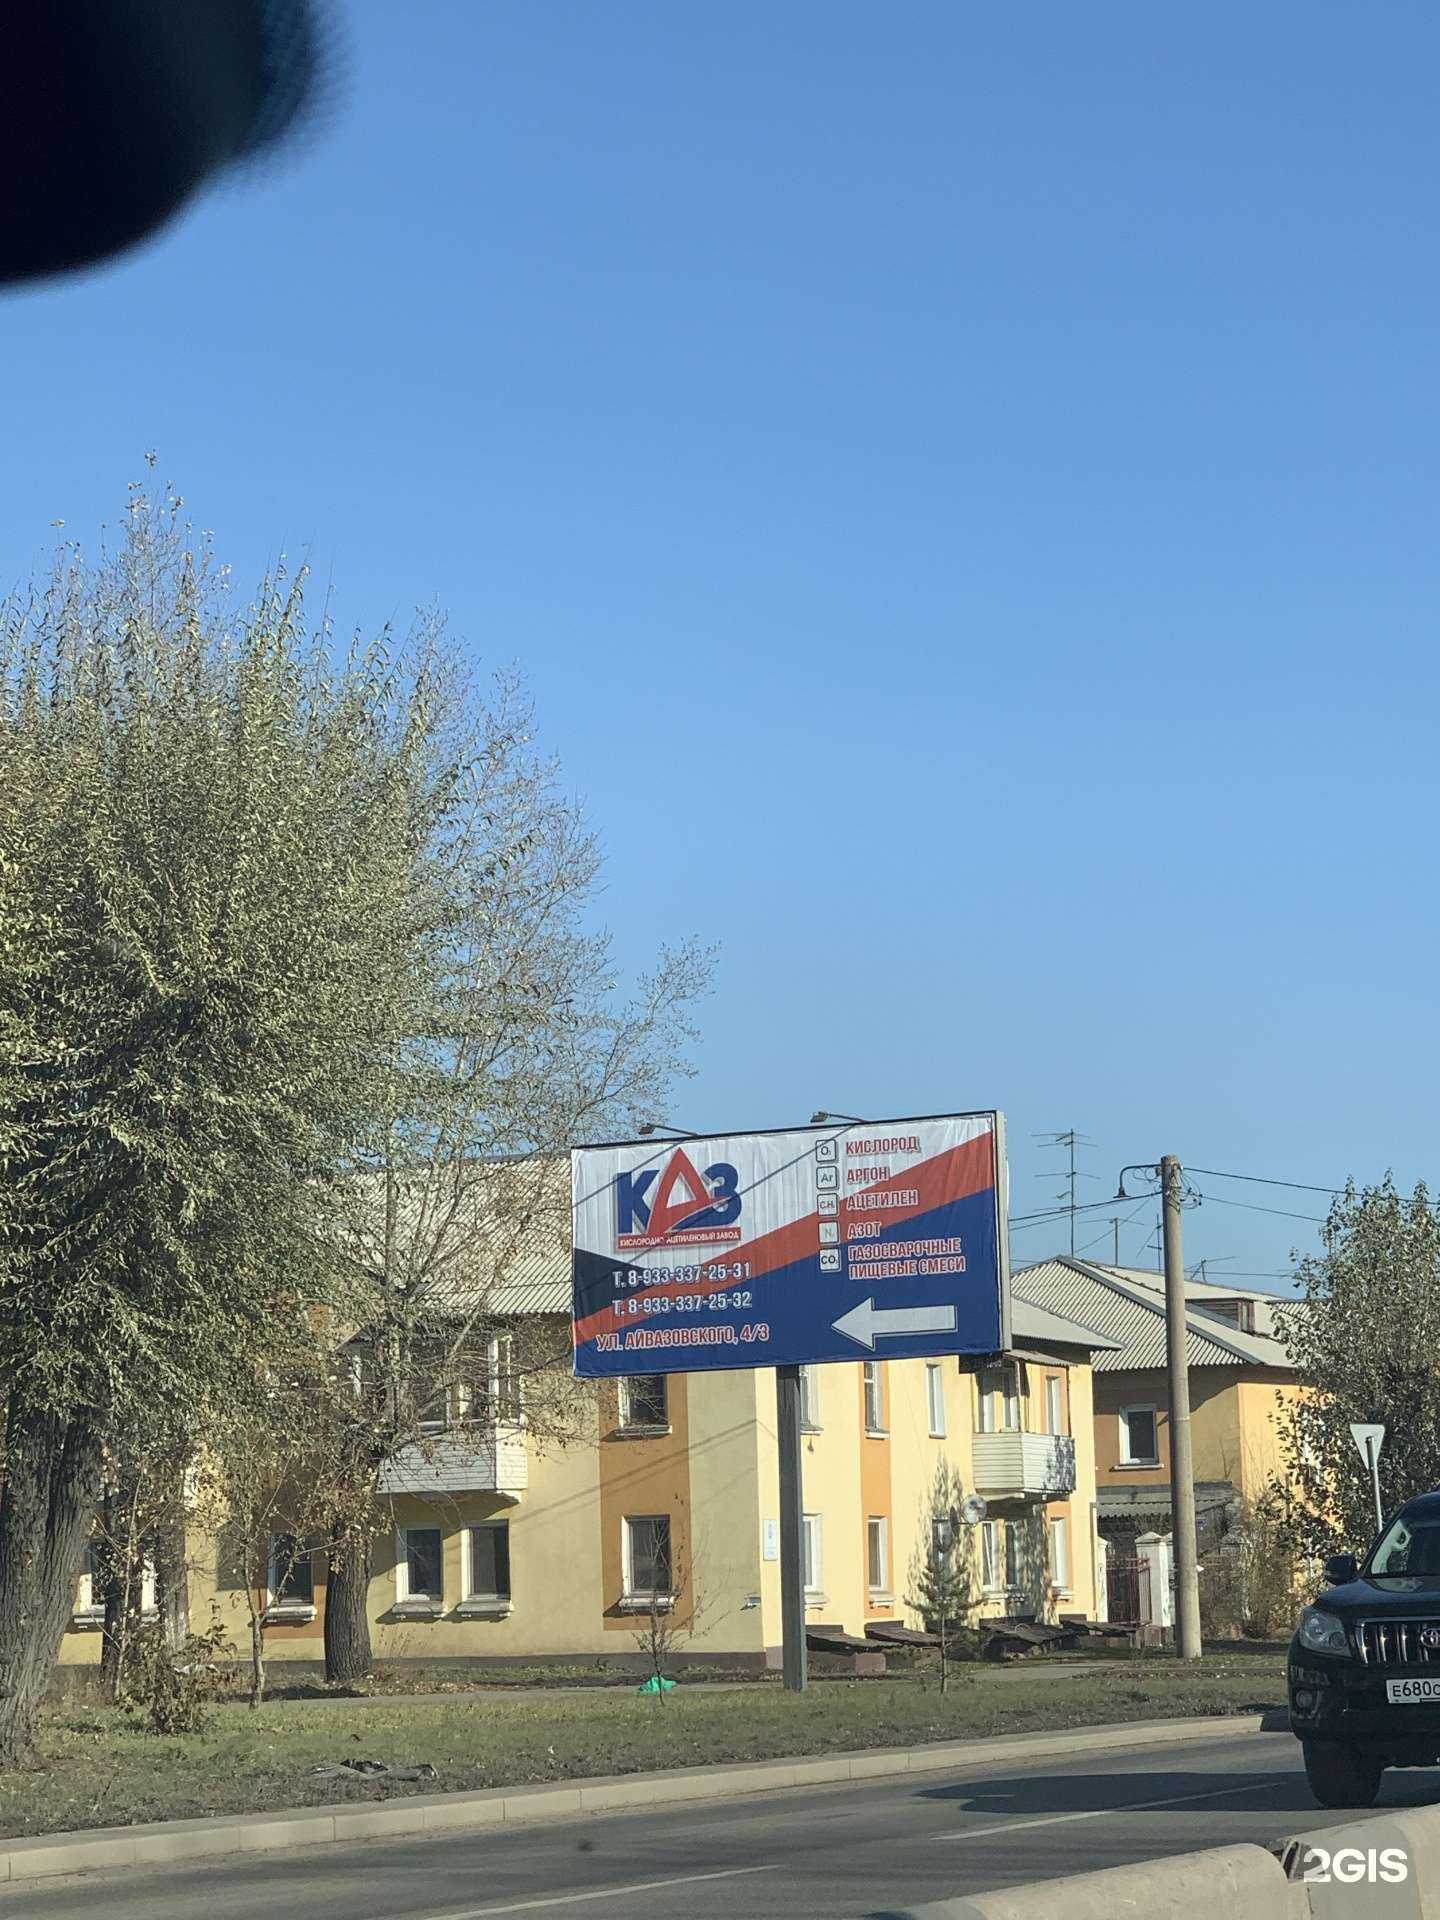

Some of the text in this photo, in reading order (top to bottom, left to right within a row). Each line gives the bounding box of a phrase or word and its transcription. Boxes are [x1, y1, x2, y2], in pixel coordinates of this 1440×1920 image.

[846, 1136, 919, 1155] КИСЛОРОД
[847, 1167, 889, 1183] АРГОН
[847, 1189, 919, 1211] АЦЕТИЛЕН
[847, 1222, 882, 1239] АЗОТ
[848, 1238, 961, 1262] ГАЗОСВАРОЧНЫЕ
[628, 1262, 751, 1286] 8-933-337-25-31
[849, 1256, 966, 1280] ПИЩЕВЫЕ СМЕСИ
[628, 1292, 752, 1313] 8-933-337-25-32
[595, 1324, 769, 1352] УЛ. АЙВАЗОВСКОГО, 4/3
